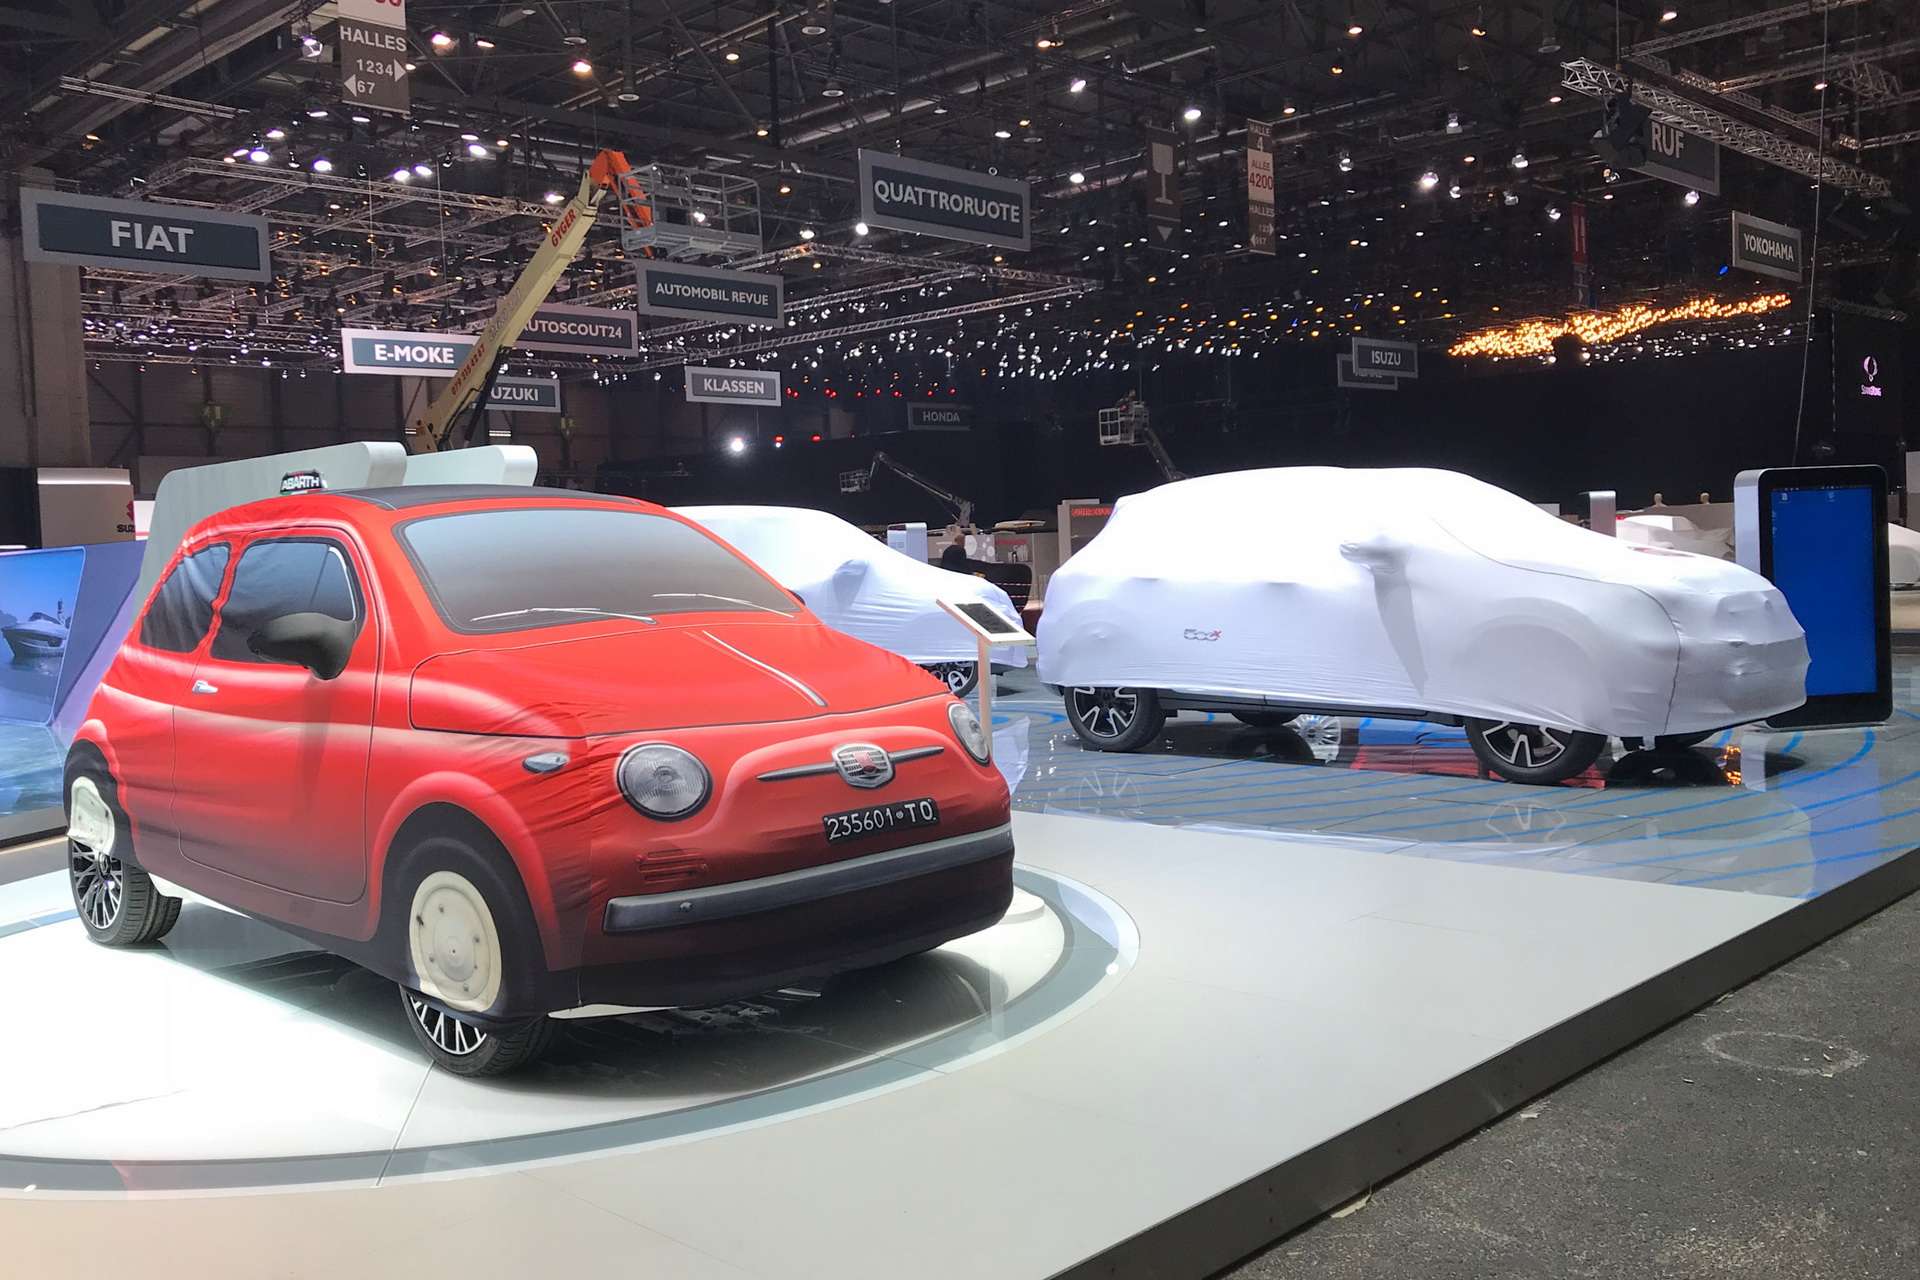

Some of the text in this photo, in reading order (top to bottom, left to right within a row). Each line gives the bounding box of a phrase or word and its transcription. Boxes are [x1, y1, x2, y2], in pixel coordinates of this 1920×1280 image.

[340, 25, 407, 52] HALLES
[357, 58, 394, 77] 1234
[357, 80, 375, 95] 67
[1250, 124, 1270, 137] HALLE
[1256, 136, 1264, 152] 4
[1651, 121, 1685, 159] RUF
[1249, 172, 1274, 190] 4200
[874, 179, 1020, 223] QUATTRORUOTE
[1249, 204, 1275, 218] HALLES
[551, 208, 576, 247] GYGER
[111, 220, 194, 254] FIAT
[1743, 233, 1795, 262] YOKOHAMA
[655, 282, 769, 306] AUTOMOBIL REVUE
[523, 319, 623, 339] UTOSCOUT24
[374, 343, 455, 365] E-MOKE
[1371, 350, 1401, 366] ISUZU
[490, 386, 539, 402] UZUKI
[703, 378, 765, 395] KLASSEN
[923, 411, 960, 422] HONDA
[281, 475, 320, 490] ABARTH
[117, 524, 135, 533] SUZ
[827, 801, 934, 841] 235601 TO
